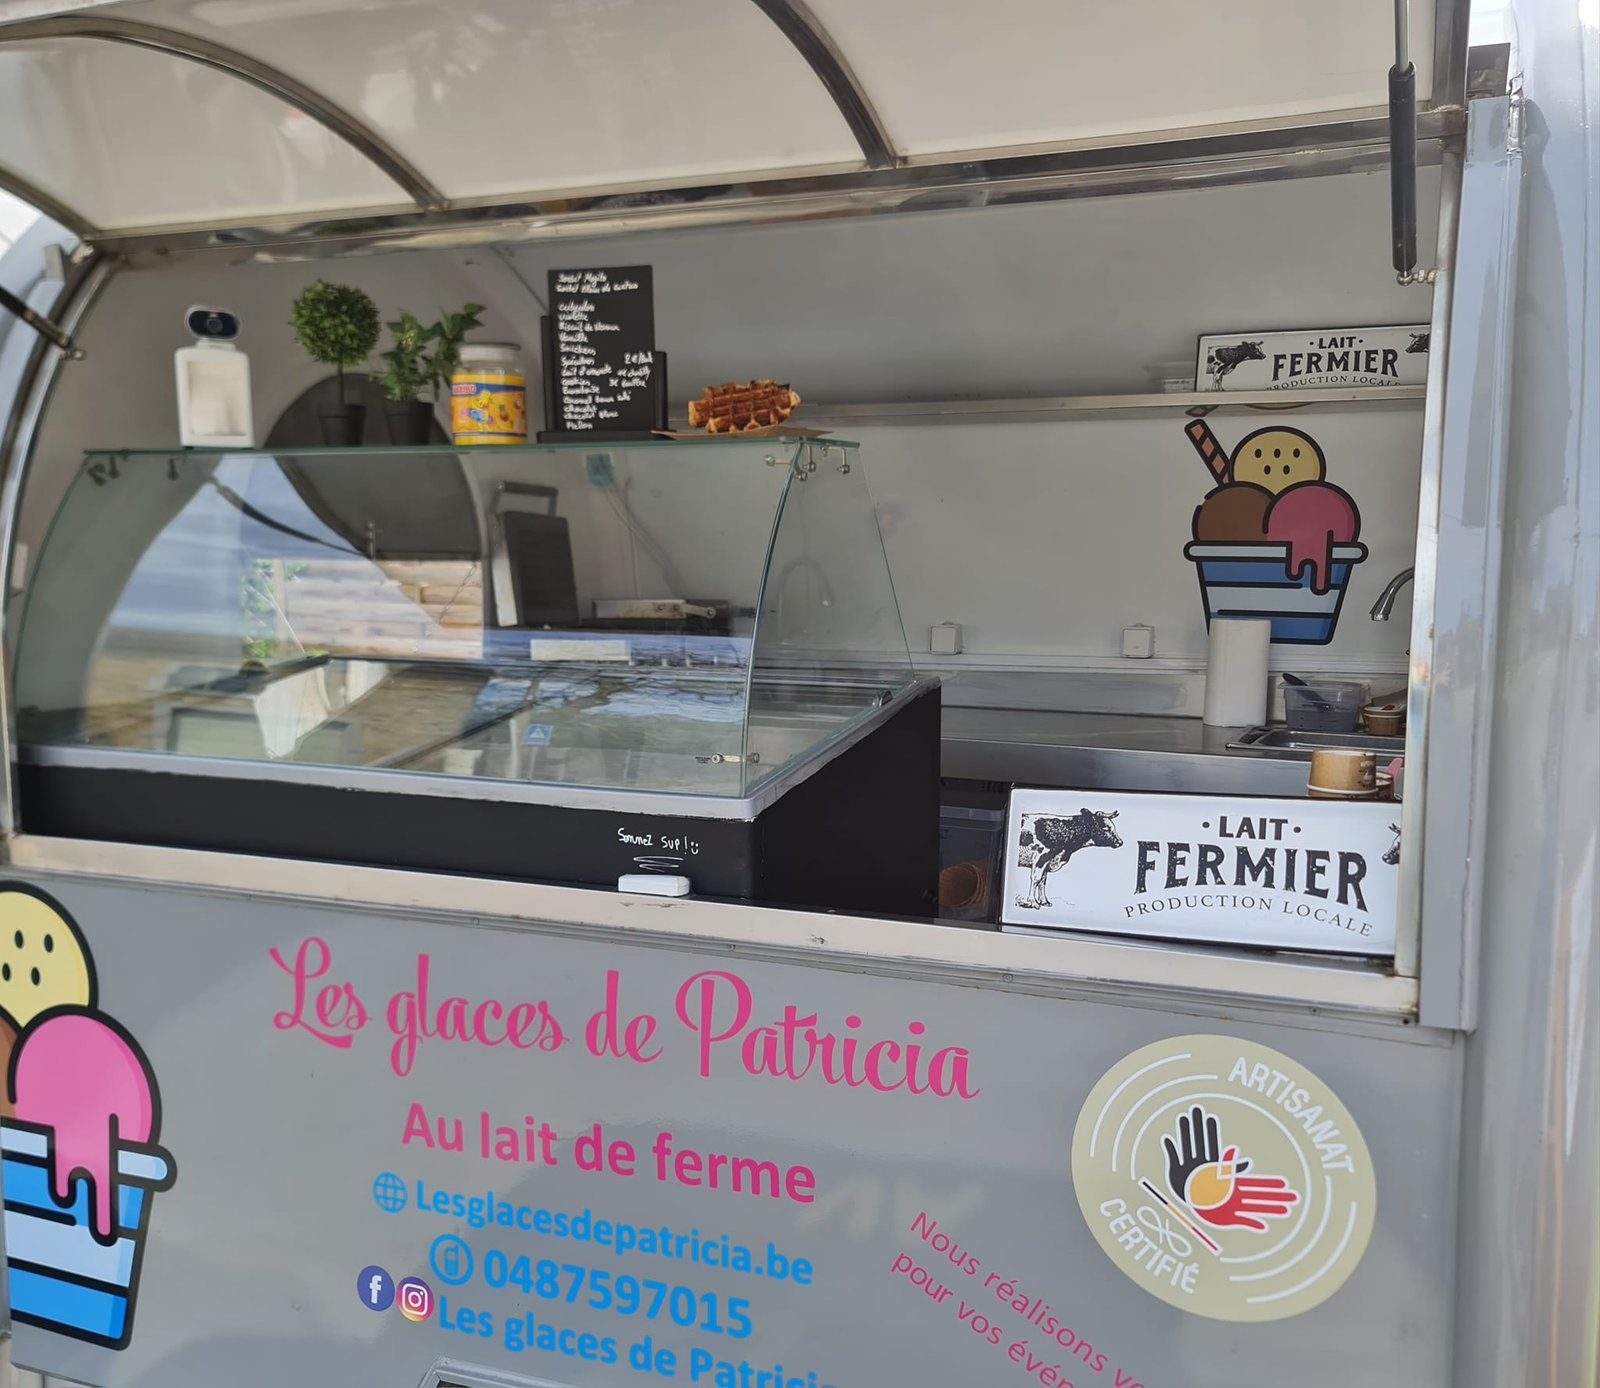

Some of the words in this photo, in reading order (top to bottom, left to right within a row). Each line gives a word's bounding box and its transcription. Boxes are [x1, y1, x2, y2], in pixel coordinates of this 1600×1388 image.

[1271, 348, 1400, 382] FERMIER
[1318, 336, 1357, 349] LAIT
[1218, 815, 1289, 841] LAIT
[1123, 893, 1274, 919] PRODUCTION
[1282, 900, 1375, 938] LOCALE
[1134, 840, 1369, 913] FERMIER
[268, 936, 374, 1050] Les
[386, 952, 572, 1077] glaces
[584, 969, 664, 1064] de
[674, 970, 981, 1099] Patricia
[401, 1102, 464, 1153] Au
[479, 1111, 559, 1167] lait
[573, 1123, 637, 1177] de
[652, 1131, 817, 1204] ferme
[1227, 1056, 1356, 1174] ARTISANAT
[415, 1179, 814, 1285] Lesglacesdepatricia.be
[1099, 1198, 1201, 1295] CERTIFIÉ
[438, 1294, 494, 1338] Les
[504, 1310, 618, 1364] glaces
[629, 1335, 677, 1378] de
[483, 1248, 753, 1339] 0487597015
[890, 1252, 954, 1304] pour
[957, 1300, 1004, 1346] vos
[910, 1211, 981, 1276] Nous
[983, 1271, 1109, 1373] réalisons
